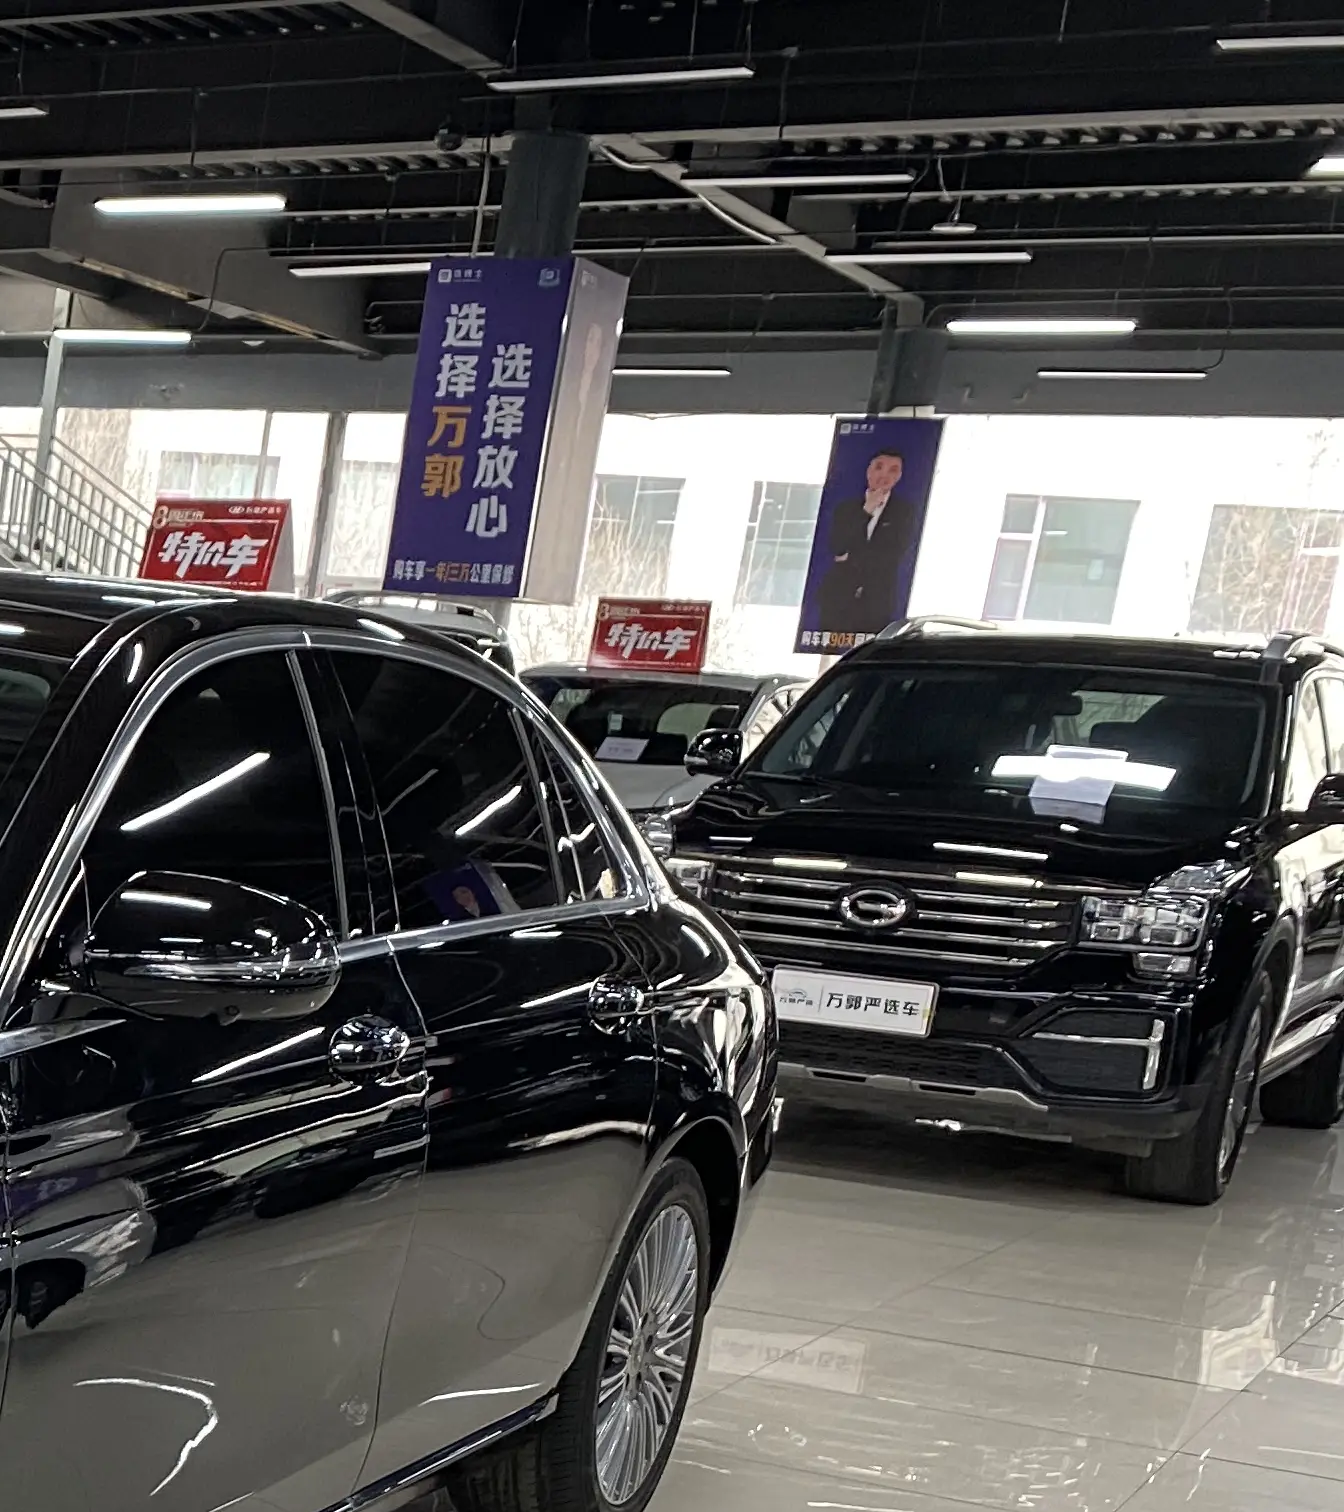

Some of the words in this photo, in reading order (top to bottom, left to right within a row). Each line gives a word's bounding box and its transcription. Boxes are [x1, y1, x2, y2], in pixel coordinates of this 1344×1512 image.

[420, 303, 487, 499] 选择万郭
[466, 343, 534, 539] 选择放心
[158, 531, 269, 579] 特价车
[604, 622, 698, 660] 特价车
[826, 992, 920, 1016] 万郭严选车
